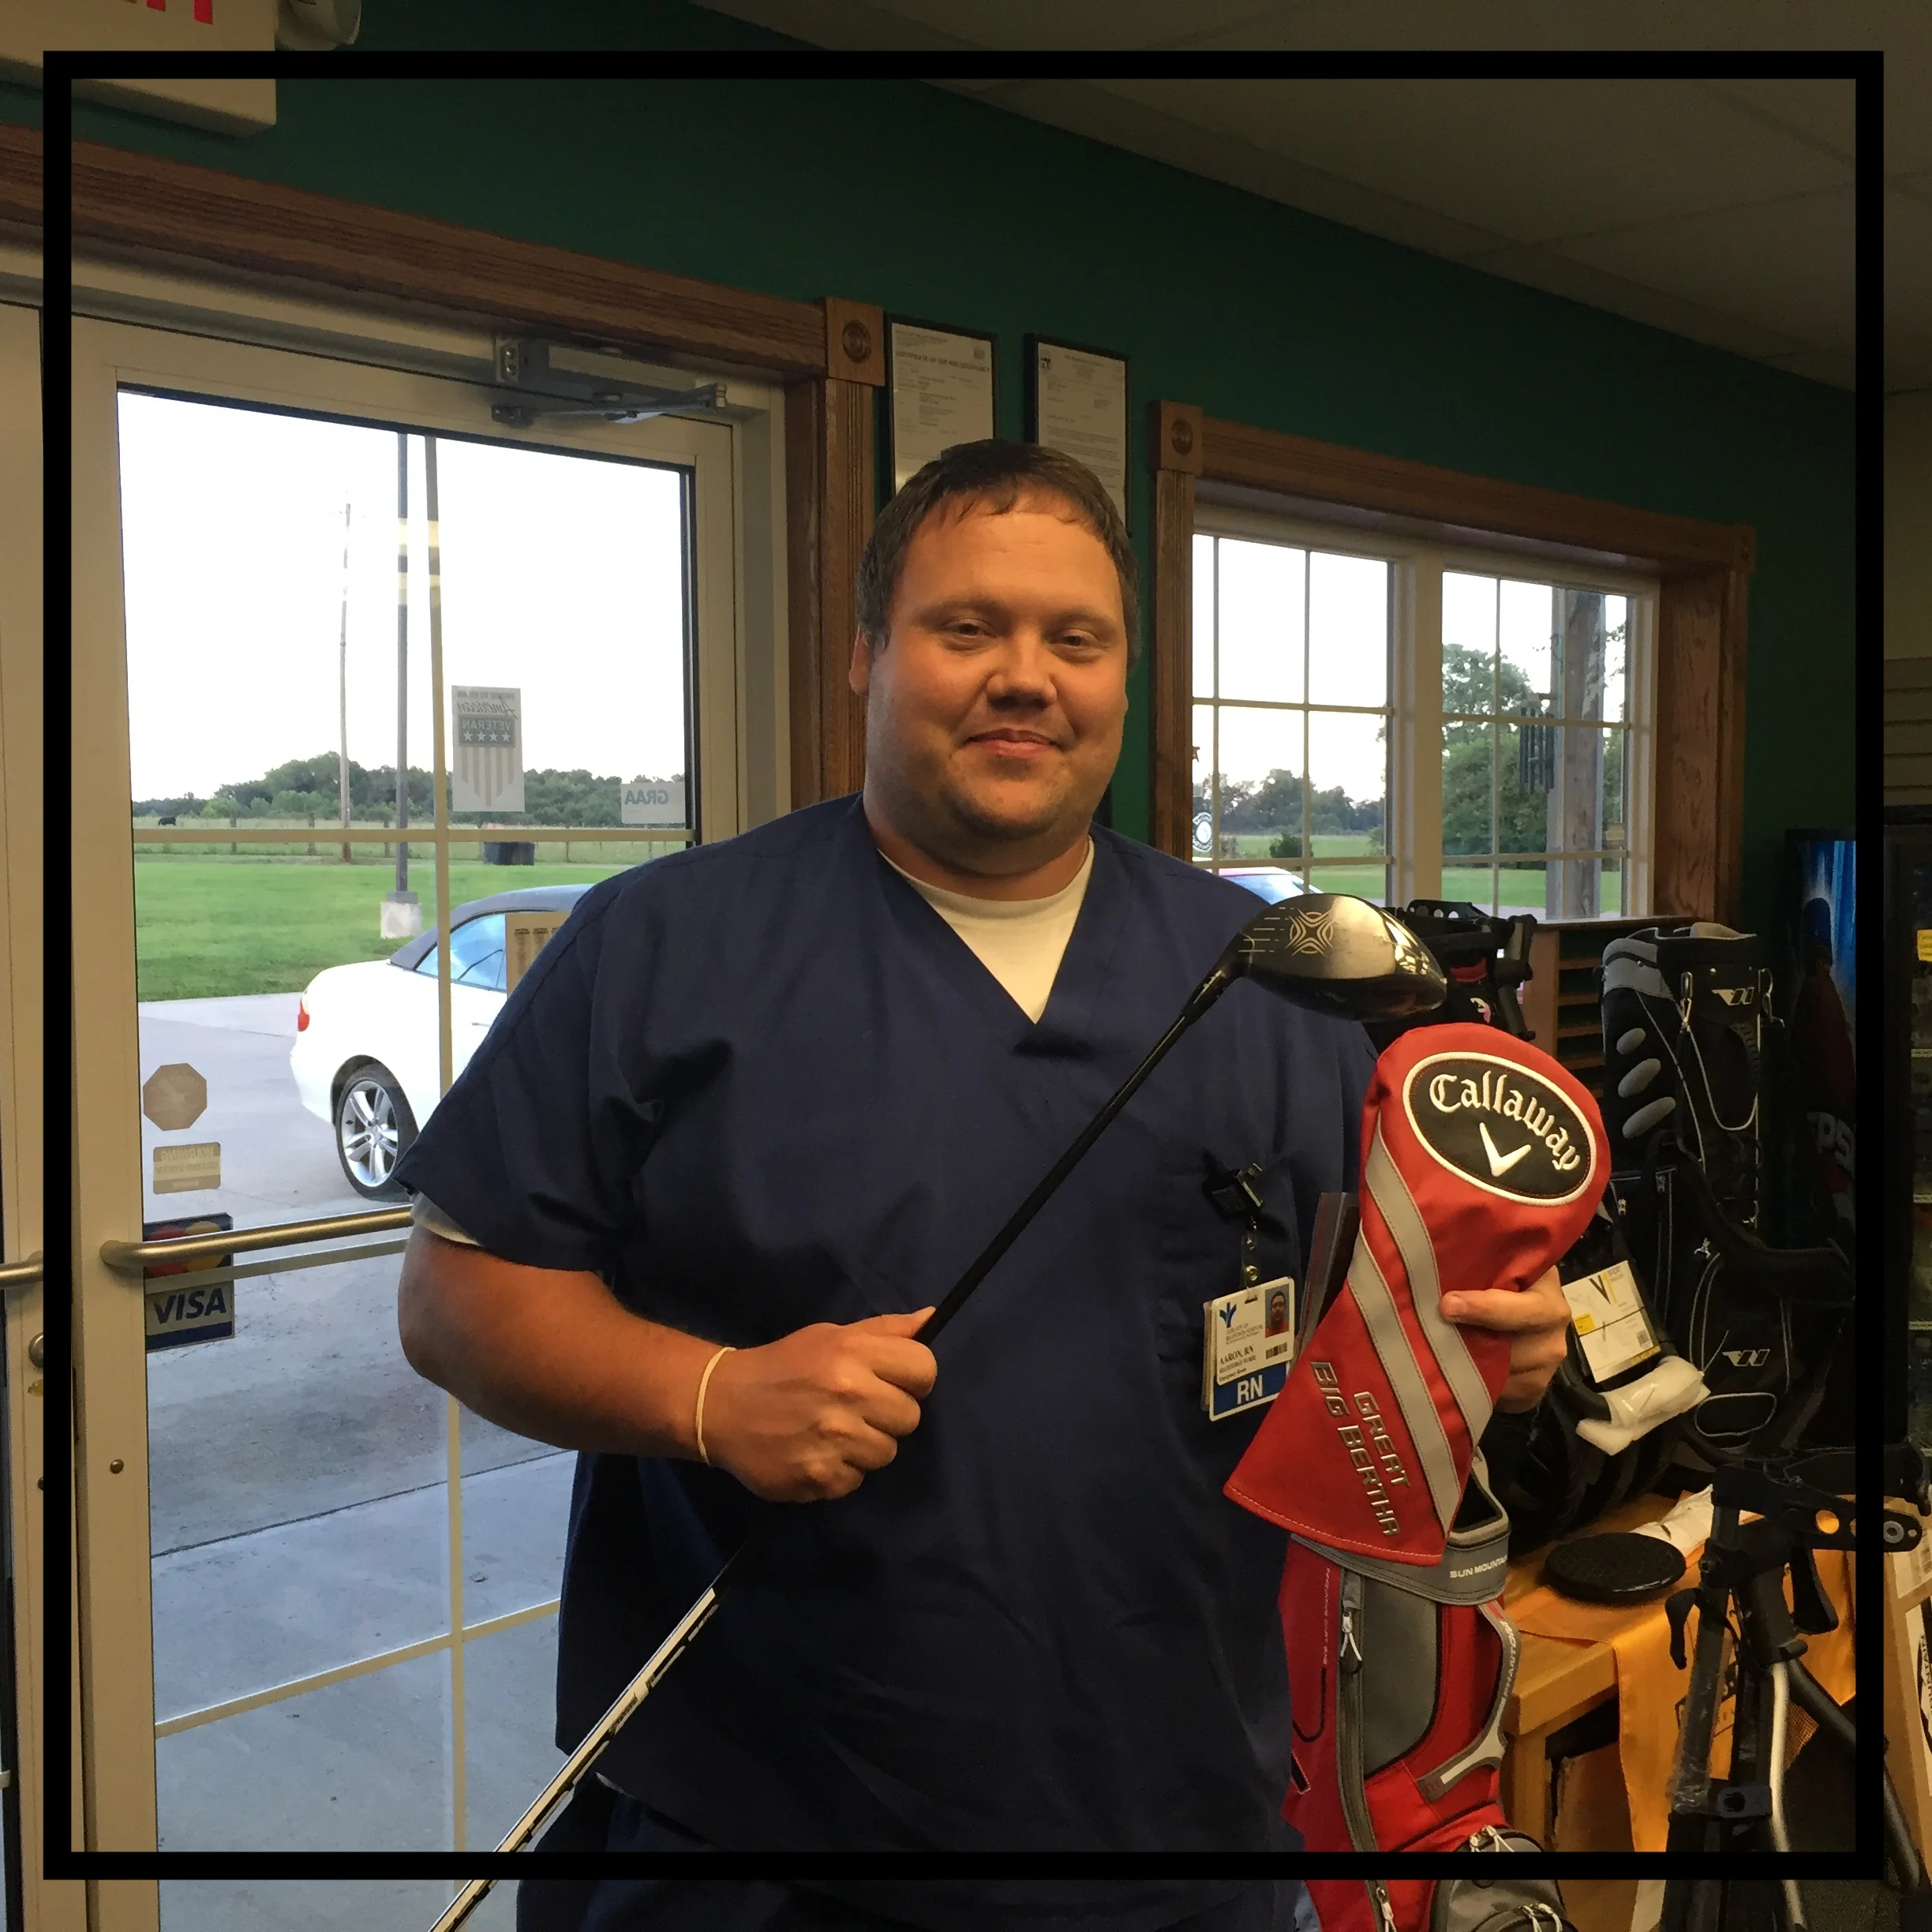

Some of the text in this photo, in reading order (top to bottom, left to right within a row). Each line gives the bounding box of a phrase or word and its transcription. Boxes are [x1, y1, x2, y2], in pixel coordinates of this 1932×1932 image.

[1429, 1069, 1582, 1171] Callaway
[154, 1287, 227, 1324] VISA
[1237, 1375, 1264, 1405] RN
[1310, 1361, 1401, 1537] BIG BERTHA
[1354, 1391, 1411, 1488] GREAT
[1450, 1553, 1508, 1578] SUN MOUNTA
[1500, 1620, 1516, 1697] PHANTOM
